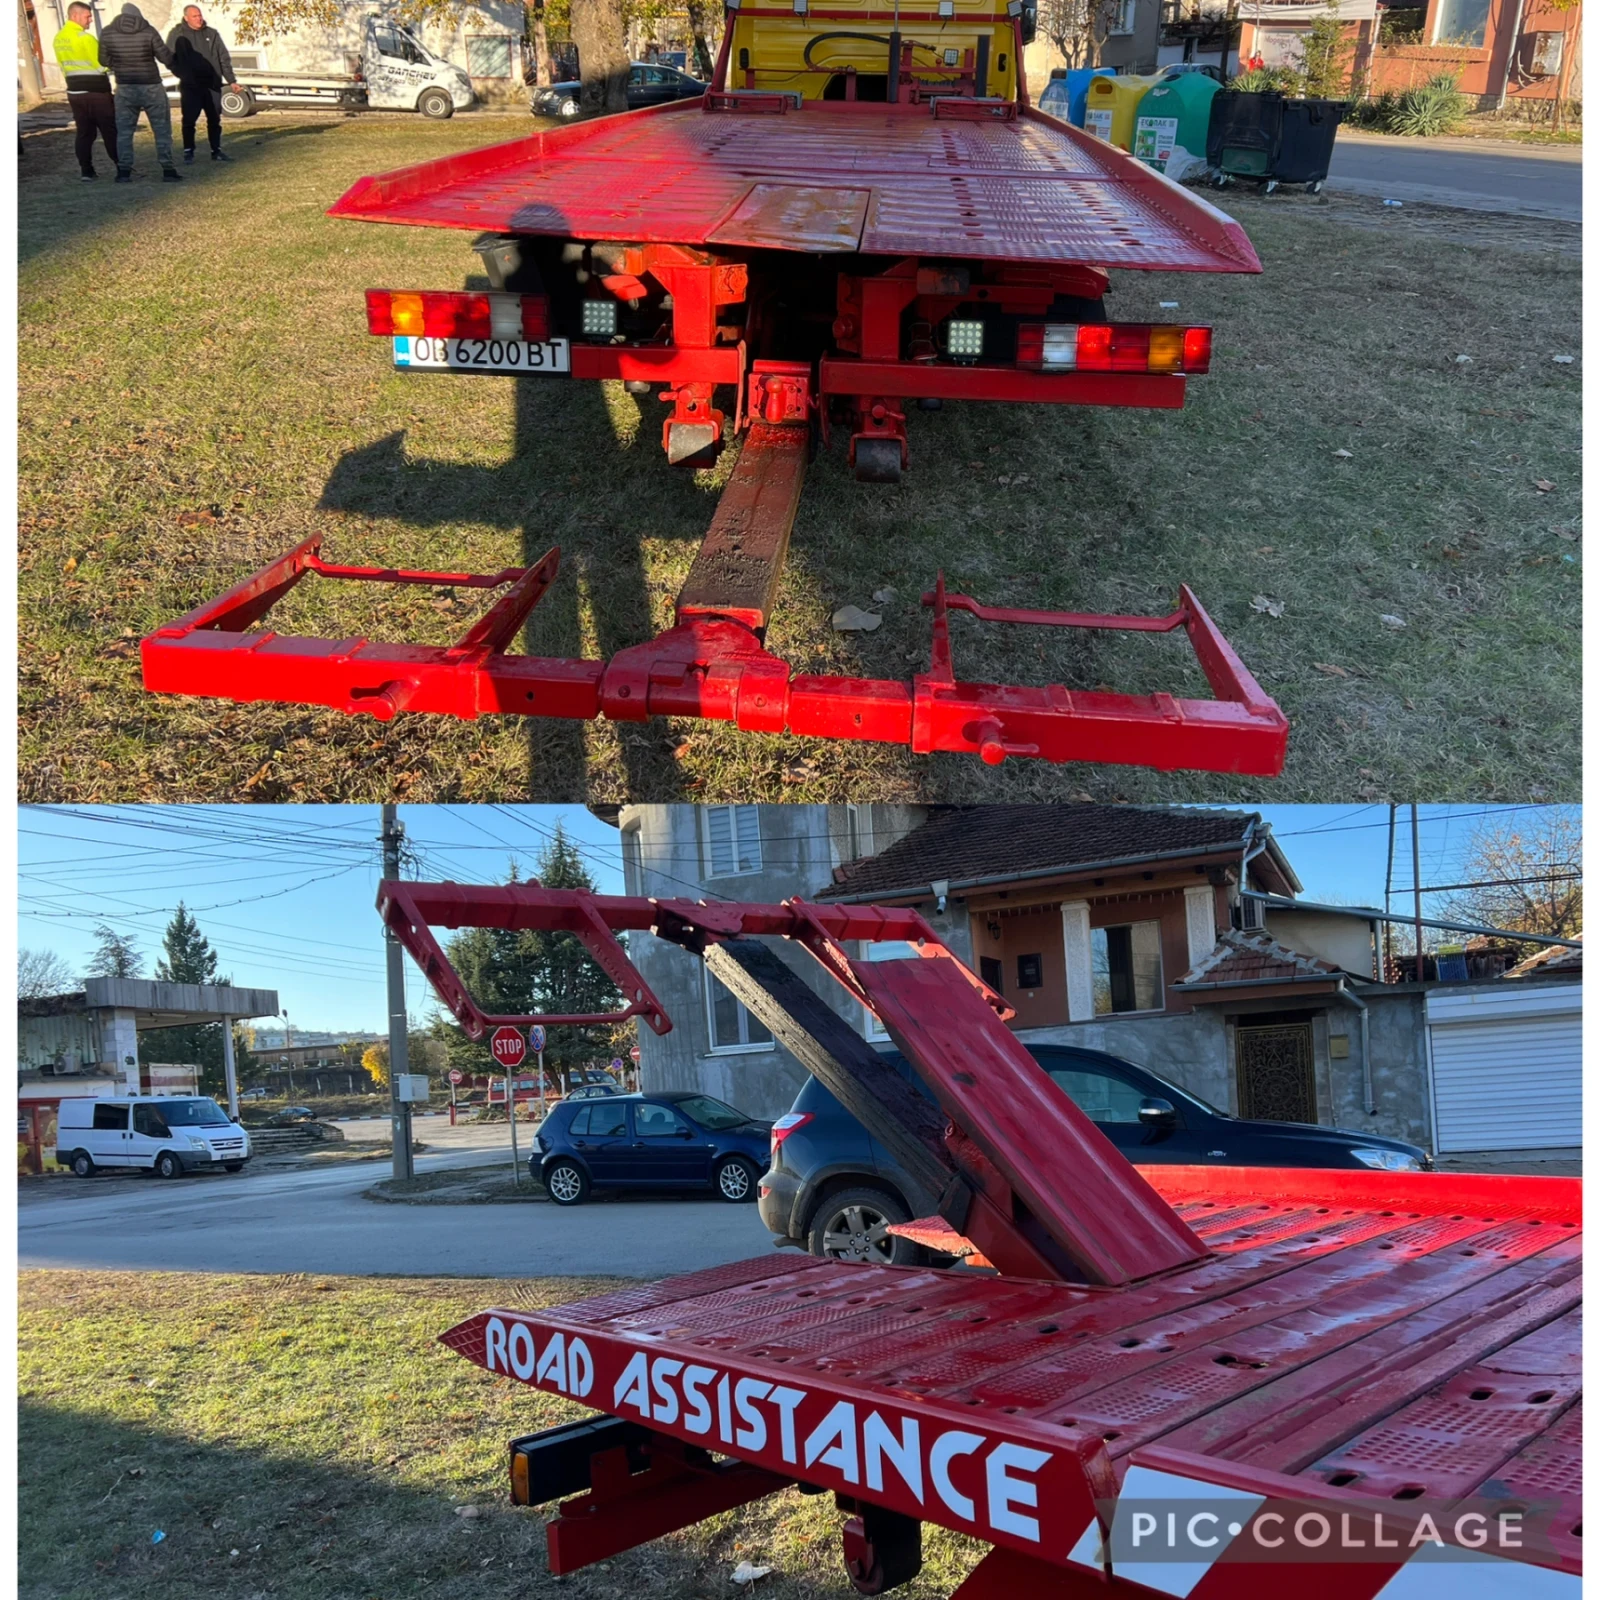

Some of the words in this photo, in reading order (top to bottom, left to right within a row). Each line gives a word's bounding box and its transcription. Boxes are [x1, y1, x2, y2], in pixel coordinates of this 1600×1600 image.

[455, 339, 521, 366] 6200
[527, 342, 562, 368] BT
[495, 1039, 522, 1055] STOP
[485, 1316, 594, 1398] ROAD
[613, 1351, 1054, 1543] ASSISTANCE
